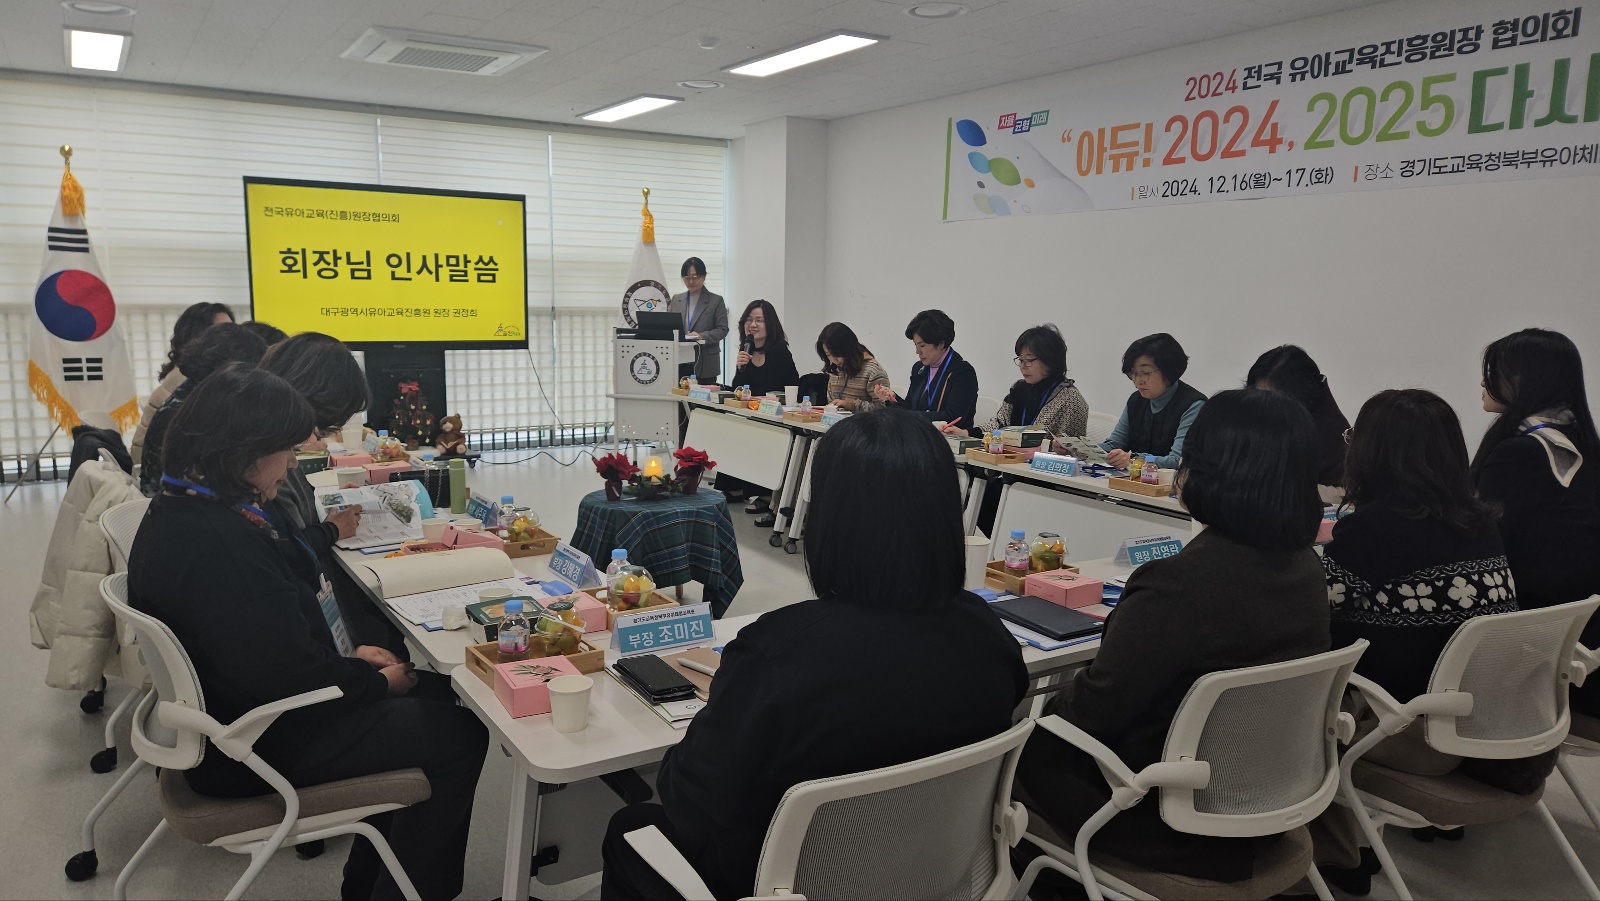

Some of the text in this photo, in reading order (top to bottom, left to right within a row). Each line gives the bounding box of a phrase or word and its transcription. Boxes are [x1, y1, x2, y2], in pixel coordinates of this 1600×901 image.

[1185, 6, 1582, 101] 2024 전국 유아교육진흥원장 협의회
[1015, 119, 1031, 132] 균형
[1032, 112, 1048, 125] 미래
[1162, 99, 1295, 166] 2024,
[1303, 72, 1457, 150] 2025
[1364, 162, 1395, 181] 장소
[279, 247, 499, 283] 회장님 인사말씀
[320, 307, 431, 318] 대구광역시유아교육진흥원
[433, 308, 450, 318] 원장
[1134, 550, 1151, 563] 원장
[628, 619, 705, 649] 부장 조미진
